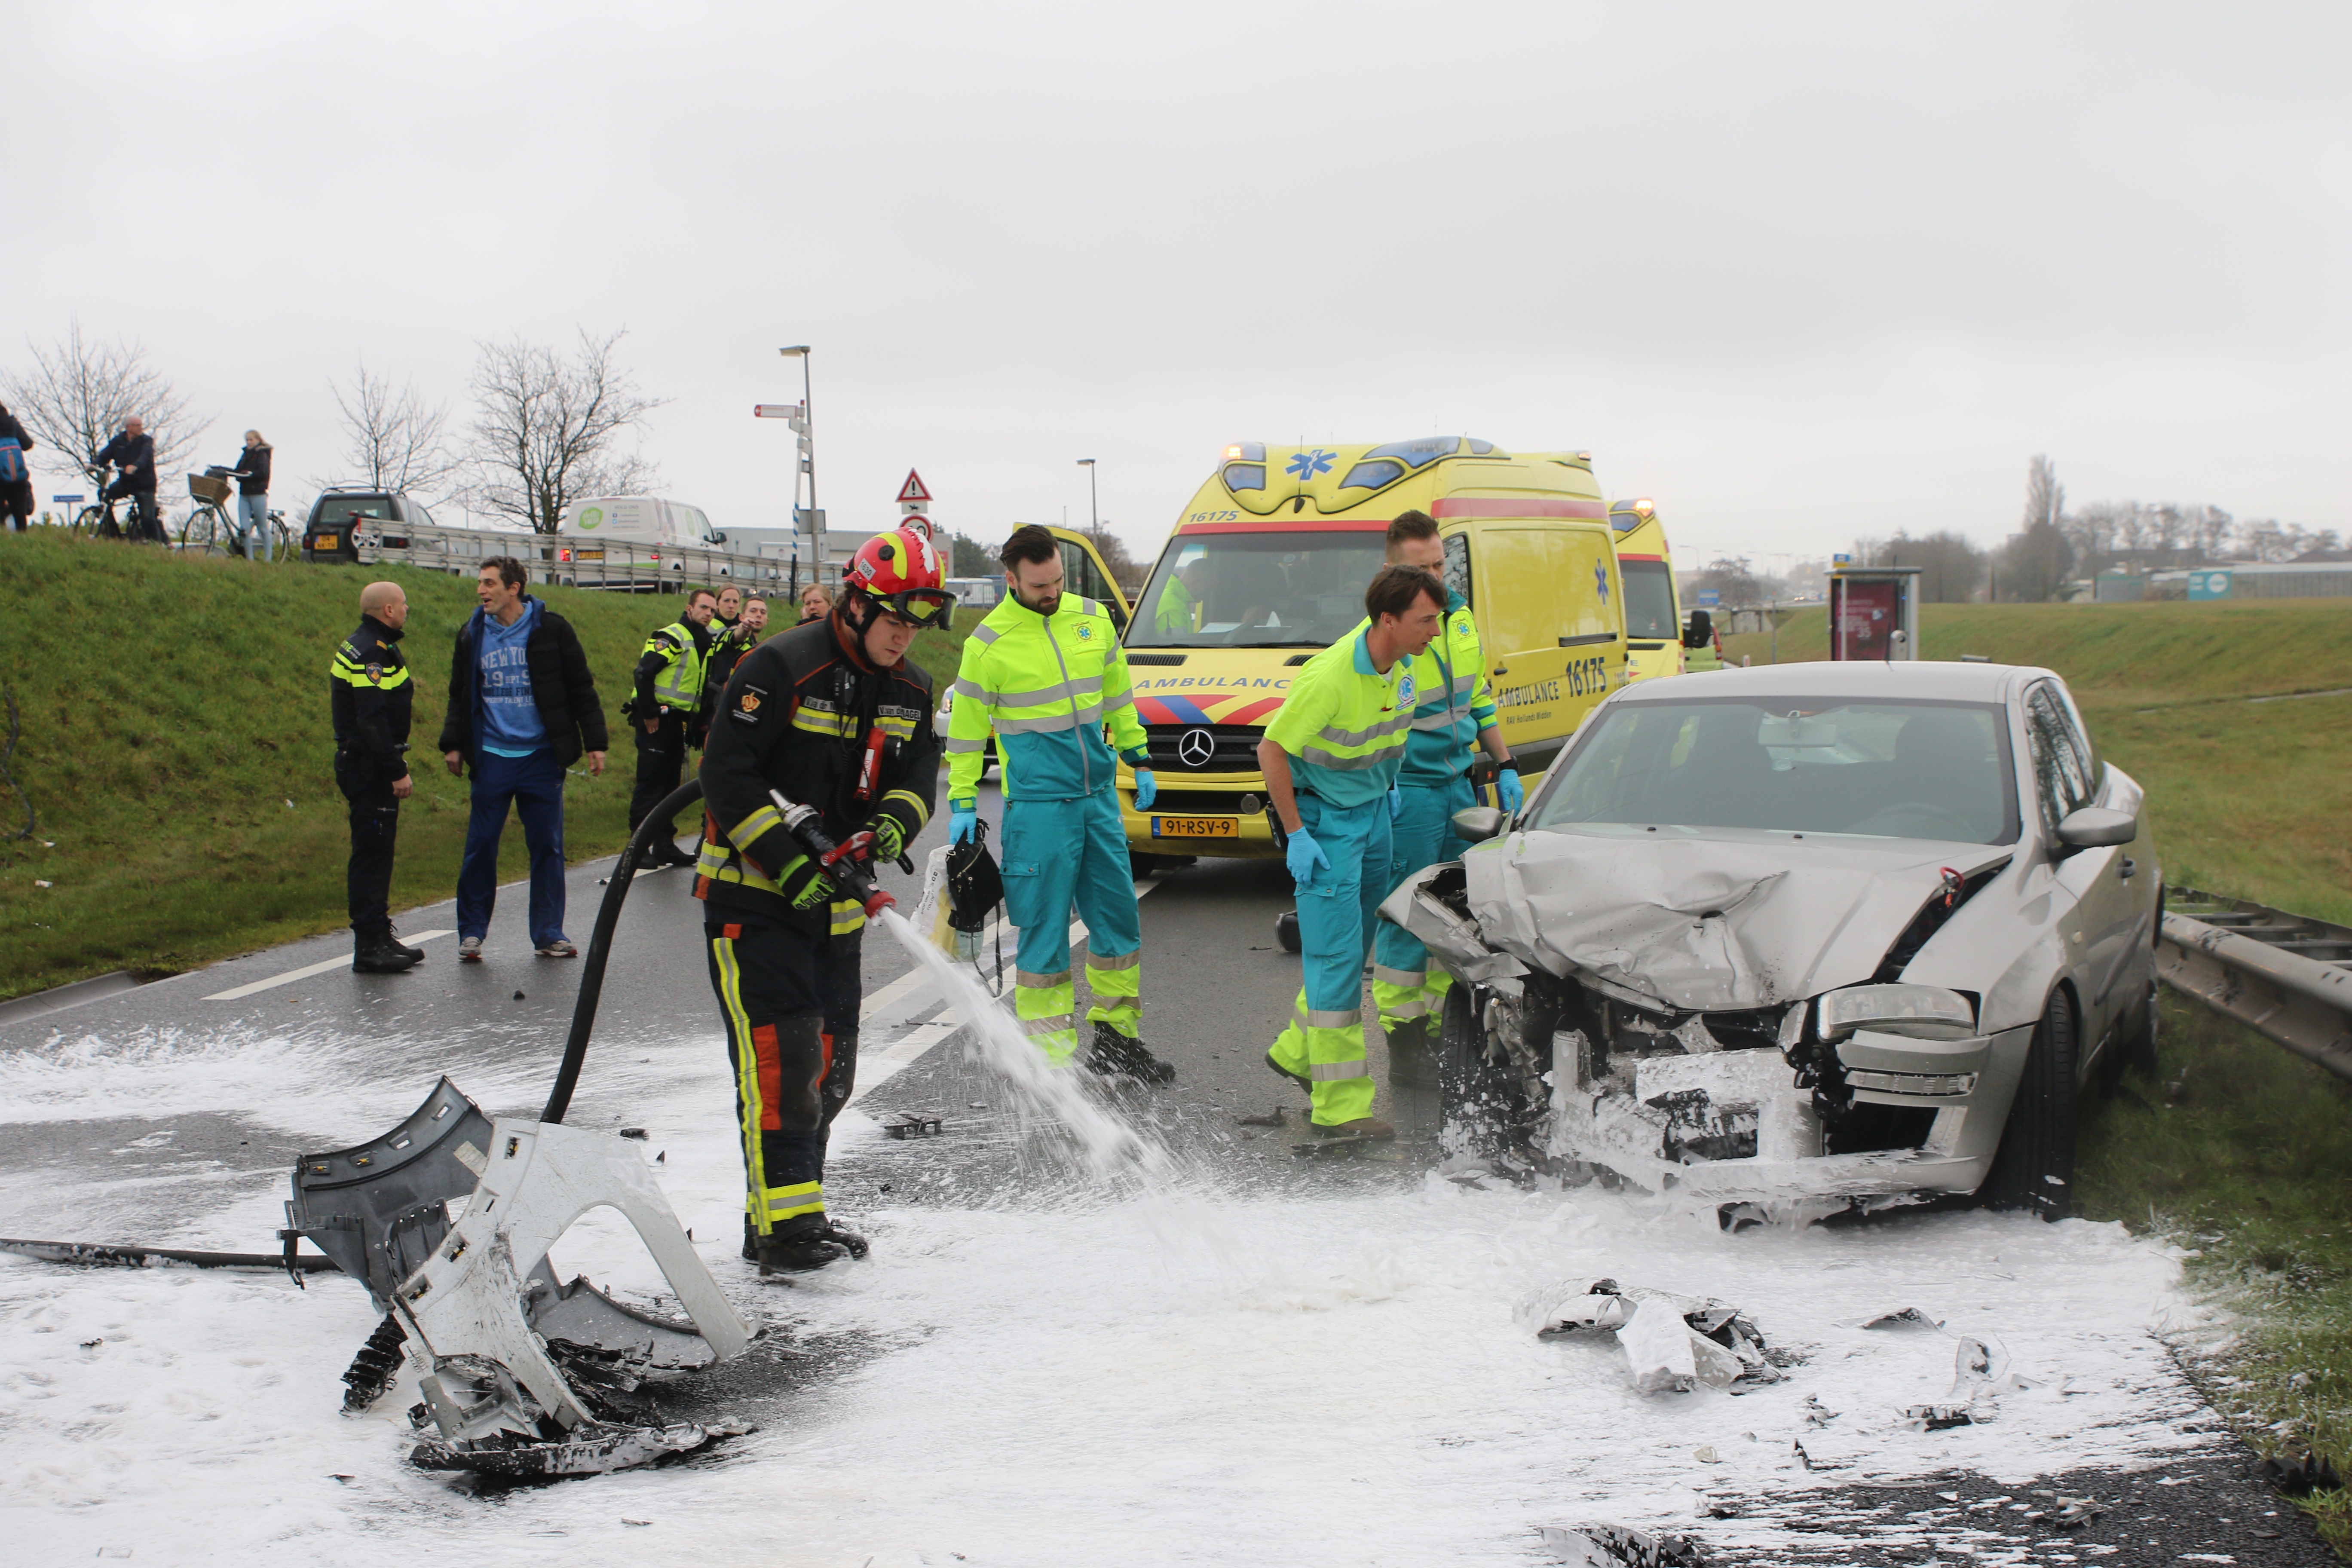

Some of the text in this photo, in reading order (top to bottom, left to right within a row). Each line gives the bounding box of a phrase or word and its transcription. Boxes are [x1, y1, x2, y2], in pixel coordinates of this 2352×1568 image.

[1189, 510, 1239, 523] 16175
[860, 562, 872, 576] 1630
[481, 646, 528, 669] NEW YO
[482, 671, 504, 688] 19
[1134, 677, 1291, 690] AMBULANC
[1566, 656, 1607, 698] 16175
[1498, 681, 1559, 708] AMBULANCE
[1506, 710, 1552, 725] RAV Hollands Midden
[1166, 820, 1230, 834] 91-RSV-9
